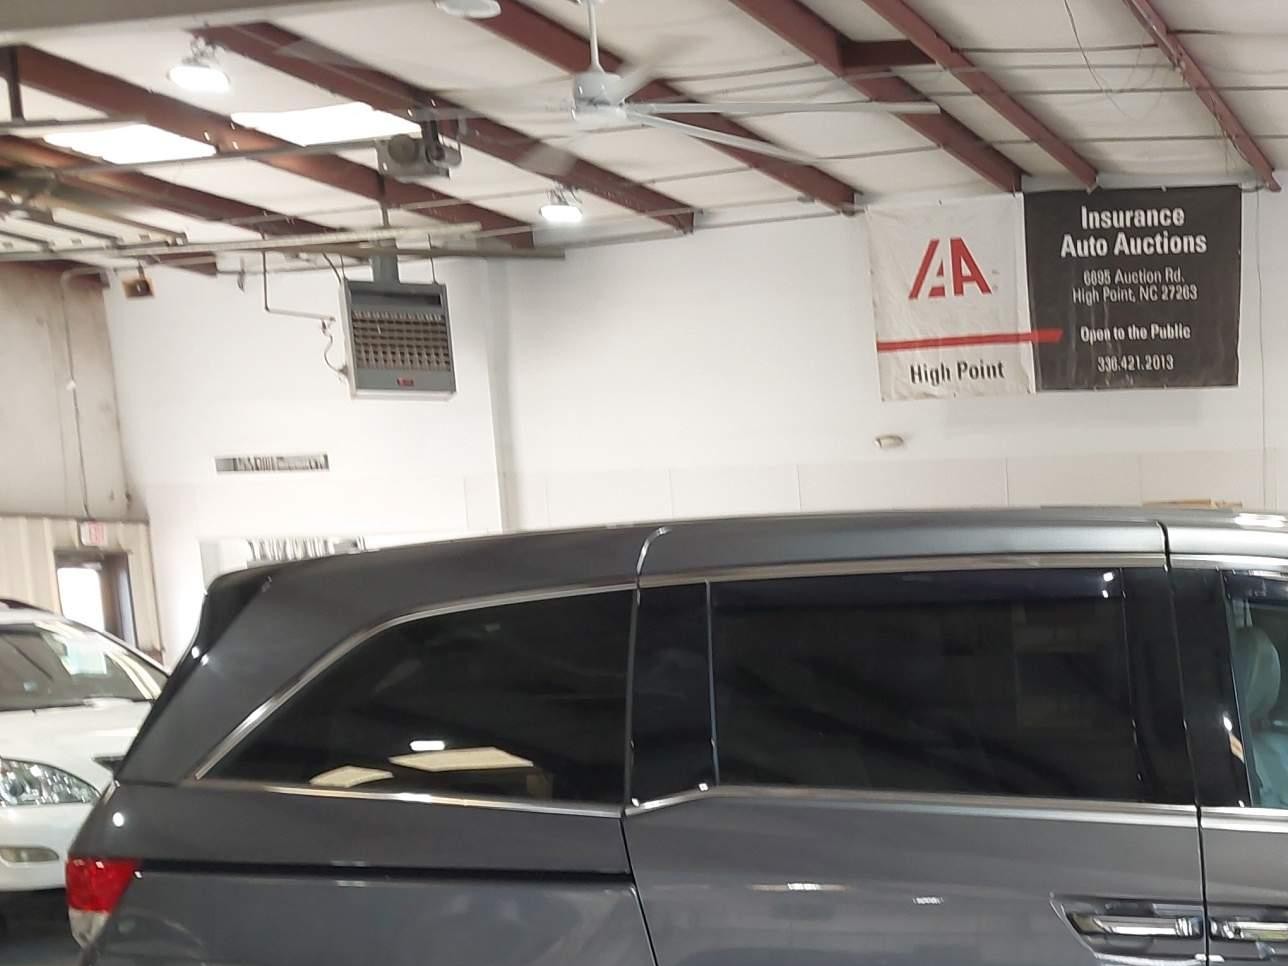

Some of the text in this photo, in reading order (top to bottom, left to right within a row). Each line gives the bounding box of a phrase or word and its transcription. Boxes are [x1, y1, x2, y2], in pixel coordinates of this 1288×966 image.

[1081, 205, 1185, 230] Insurance
[1060, 230, 1208, 258] Auto Auctions
[1114, 268, 1162, 284] Auction
[1165, 266, 1185, 283] Rd.
[1072, 286, 1100, 306] High
[1139, 284, 1158, 301] NC
[1080, 322, 1192, 346] Open to the Public
[910, 358, 1005, 386] High Point
